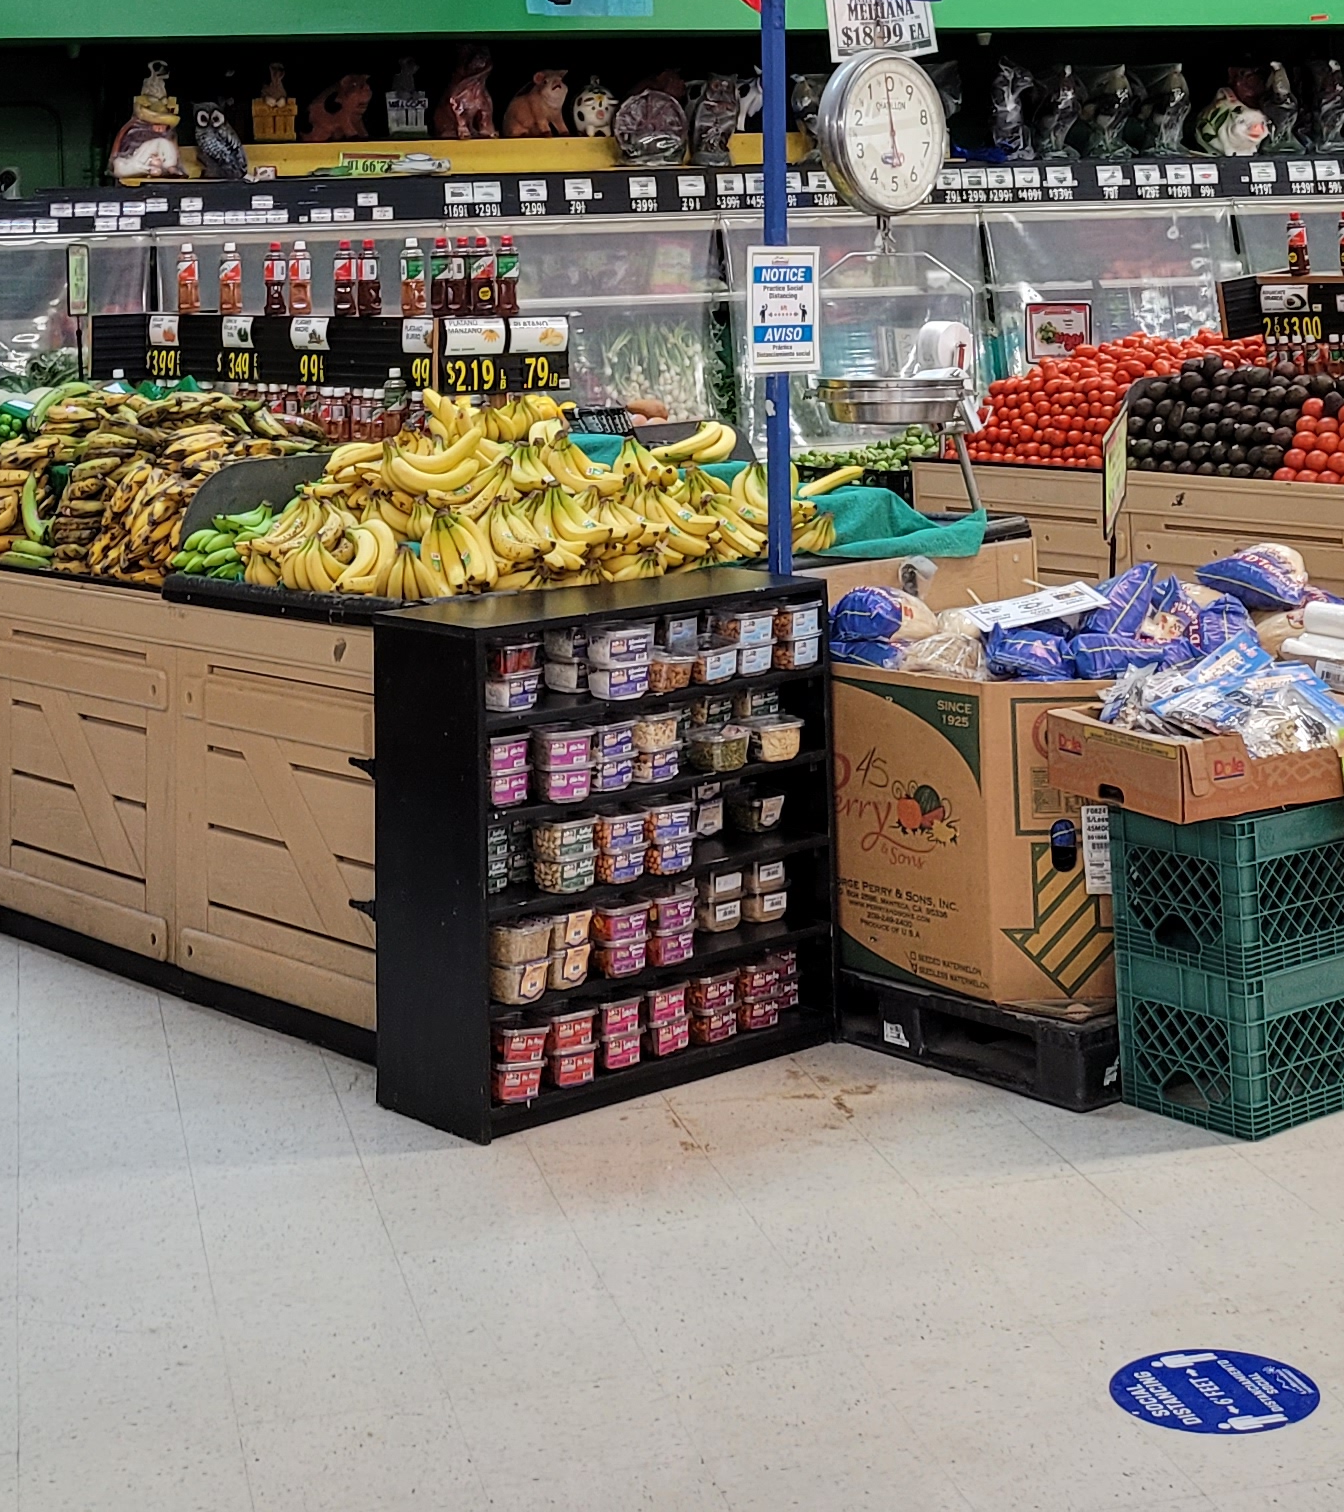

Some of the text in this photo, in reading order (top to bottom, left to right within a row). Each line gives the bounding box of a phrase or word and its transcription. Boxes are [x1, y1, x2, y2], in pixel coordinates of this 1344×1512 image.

[909, 23, 925, 41] EA
[867, 83, 872, 100] 1
[886, 76, 894, 92] 0
[905, 85, 913, 101] 9
[875, 101, 906, 111] CHATLLON
[855, 110, 863, 126] 2
[920, 109, 928, 125] 8
[856, 143, 865, 159] 3
[922, 141, 930, 158] 7
[870, 168, 878, 184] 4
[910, 166, 918, 182] 6
[891, 176, 898, 192] 5
[761, 268, 806, 282] NOTICE
[764, 327, 802, 342] AVISO
[937, 700, 973, 715] SINCE
[942, 715, 970, 728] 1925
[1214, 756, 1245, 776] Dole
[889, 847, 926, 870] Sons
[862, 881, 893, 896] PERRY
[938, 898, 959, 912] INC.
[1133, 1370, 1204, 1426] DISTANCING
[1189, 1377, 1225, 1403] FEET
[1125, 1383, 1171, 1418] SOCIAL
